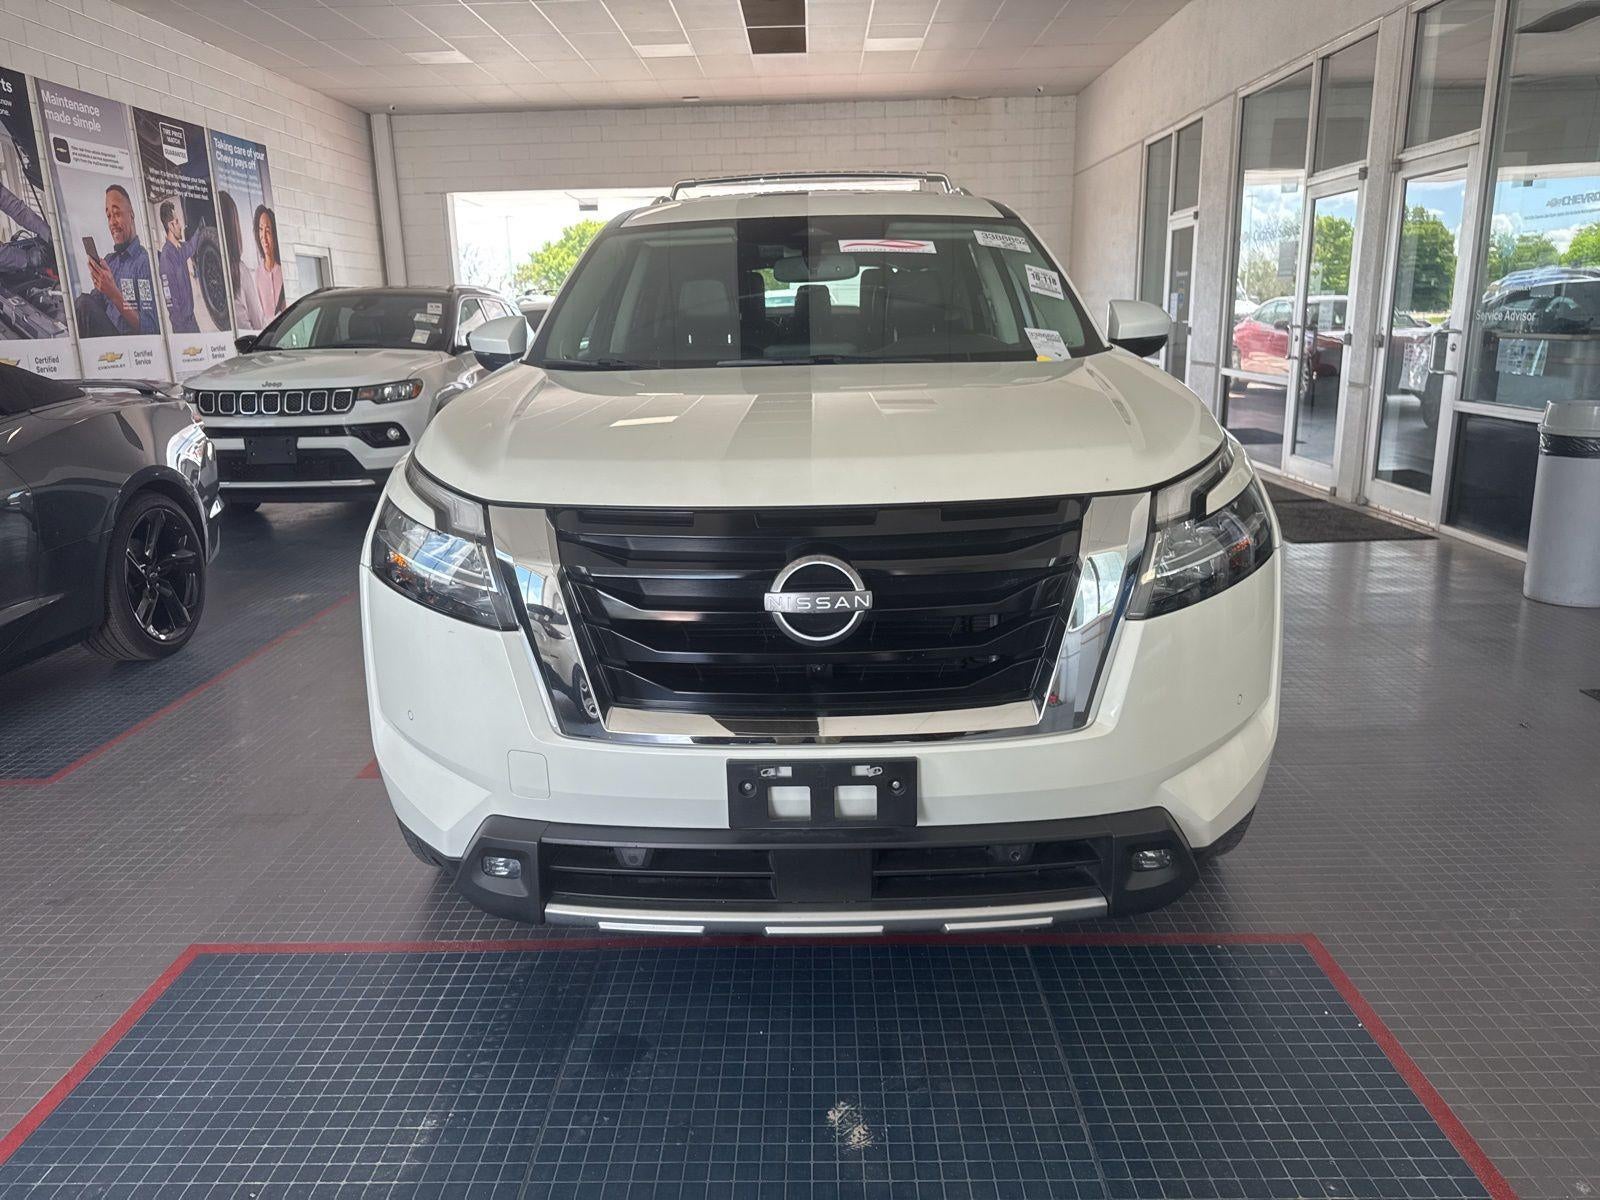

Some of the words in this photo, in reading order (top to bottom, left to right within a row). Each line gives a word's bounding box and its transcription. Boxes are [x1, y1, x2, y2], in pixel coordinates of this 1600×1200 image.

[41, 89, 100, 117] Maintenance
[44, 108, 71, 125] made
[72, 114, 101, 133] simple
[213, 137, 233, 155] Taking
[233, 145, 246, 157] care
[246, 147, 253, 158] of
[252, 150, 265, 161] your
[215, 150, 234, 167] Chevy
[234, 158, 247, 170] pays
[247, 159, 256, 170] off
[1476, 310, 1502, 320] Service
[1504, 310, 1536, 322] Advisor
[34, 355, 60, 364] Certified
[133, 349, 153, 358] Certified
[36, 365, 58, 373] Service
[261, 380, 282, 388] Jeep
[768, 594, 871, 610] NISSAN
